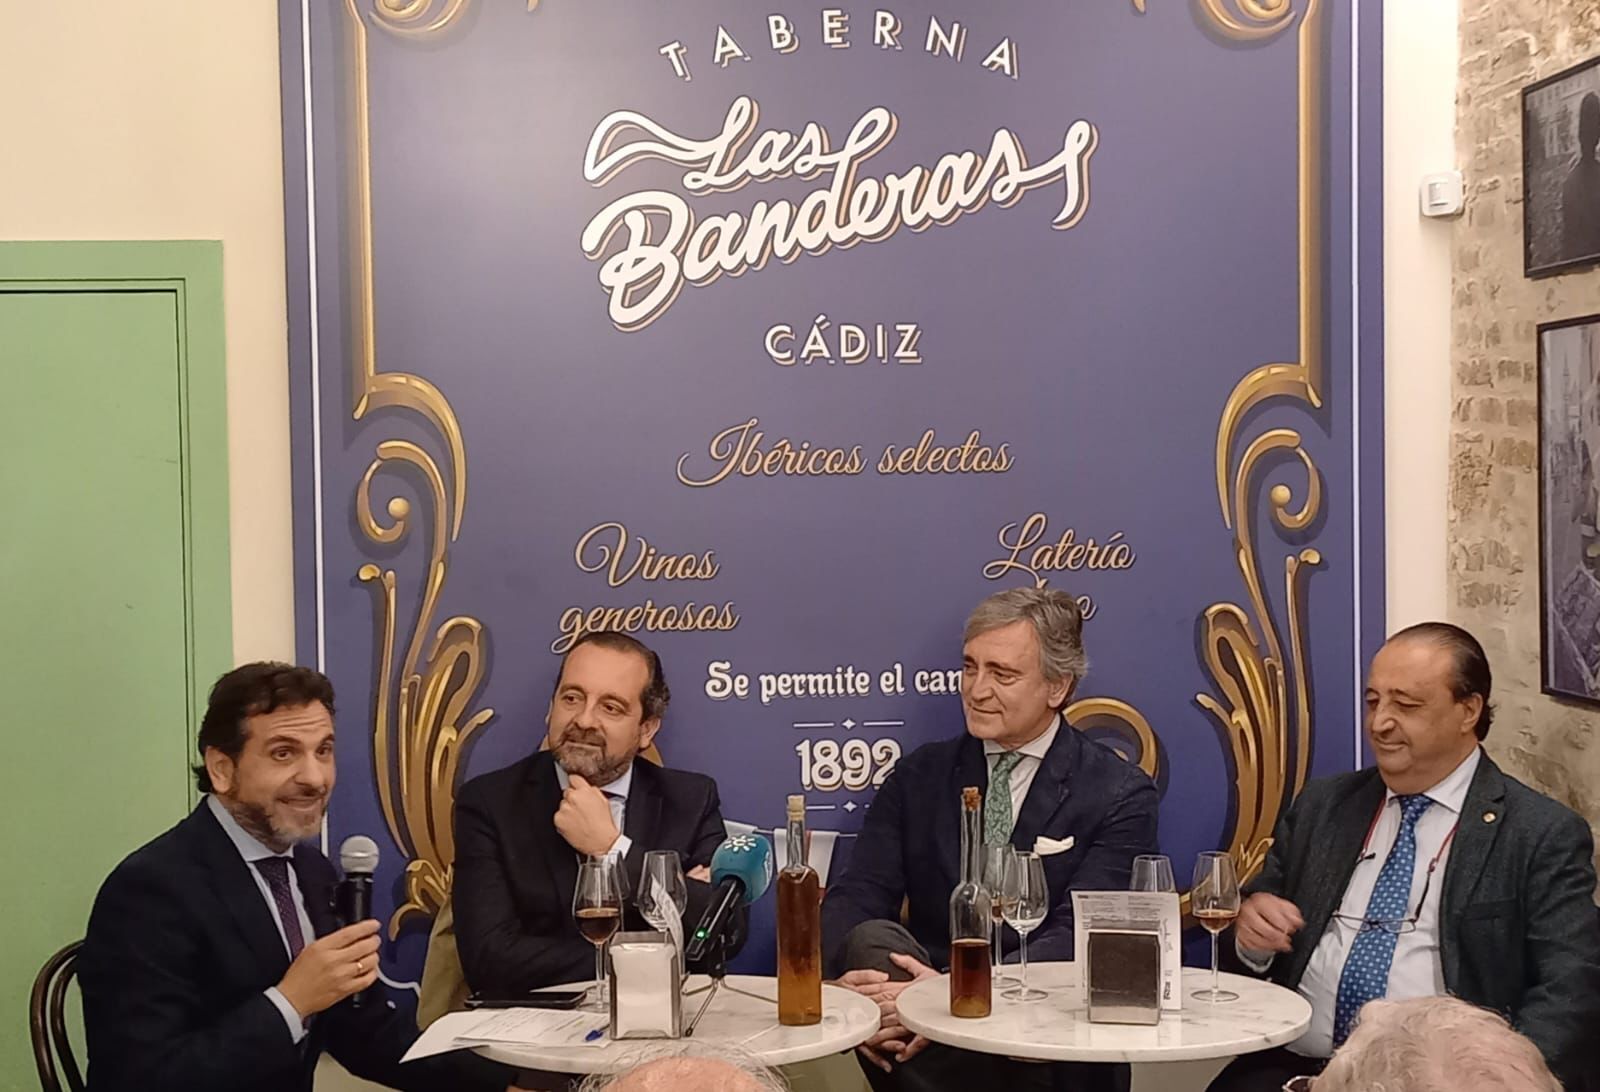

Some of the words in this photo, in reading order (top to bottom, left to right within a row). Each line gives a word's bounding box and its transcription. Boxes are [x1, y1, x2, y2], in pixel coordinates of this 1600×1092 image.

[659, 8, 1020, 81] TABERNA
[580, 106, 1098, 332] Banderas
[764, 314, 923, 365] CÁDIZ
[676, 418, 868, 487] Ibéricos
[877, 429, 1015, 474] selectos
[575, 522, 721, 587] Vinos
[983, 513, 1136, 589] Laterío
[550, 599, 741, 654] generosos
[705, 661, 749, 699] Se
[759, 665, 870, 705] permite
[879, 663, 905, 695] el
[795, 738, 902, 791] 1892
